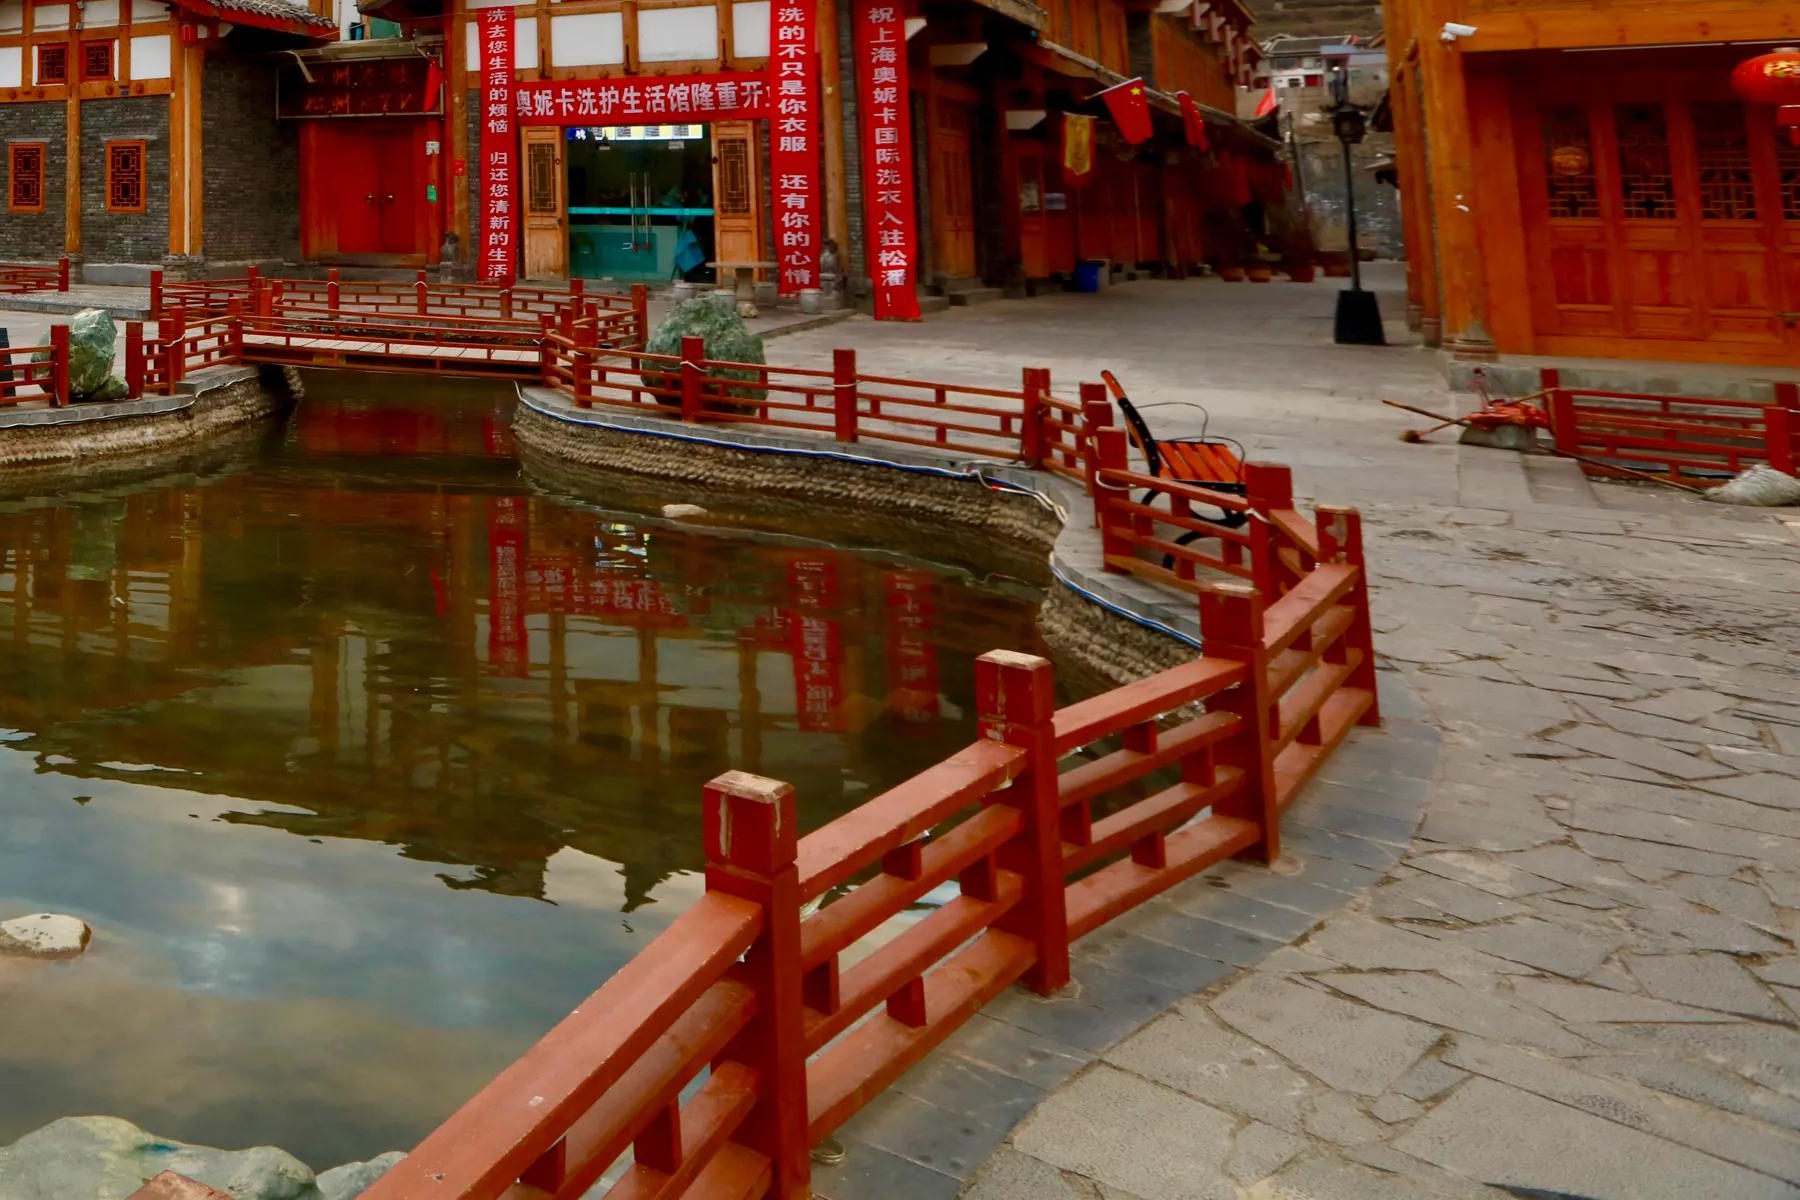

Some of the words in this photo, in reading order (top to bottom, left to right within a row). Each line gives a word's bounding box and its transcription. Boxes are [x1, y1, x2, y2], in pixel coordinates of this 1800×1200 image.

[487, 9, 509, 134] 洗去您生活的烦恼
[516, 80, 771, 117] 奥妮卡洗护生活馆隆重开
[488, 151, 510, 278] 归还您清新的生活
[779, 174, 811, 285] 还有你的心情
